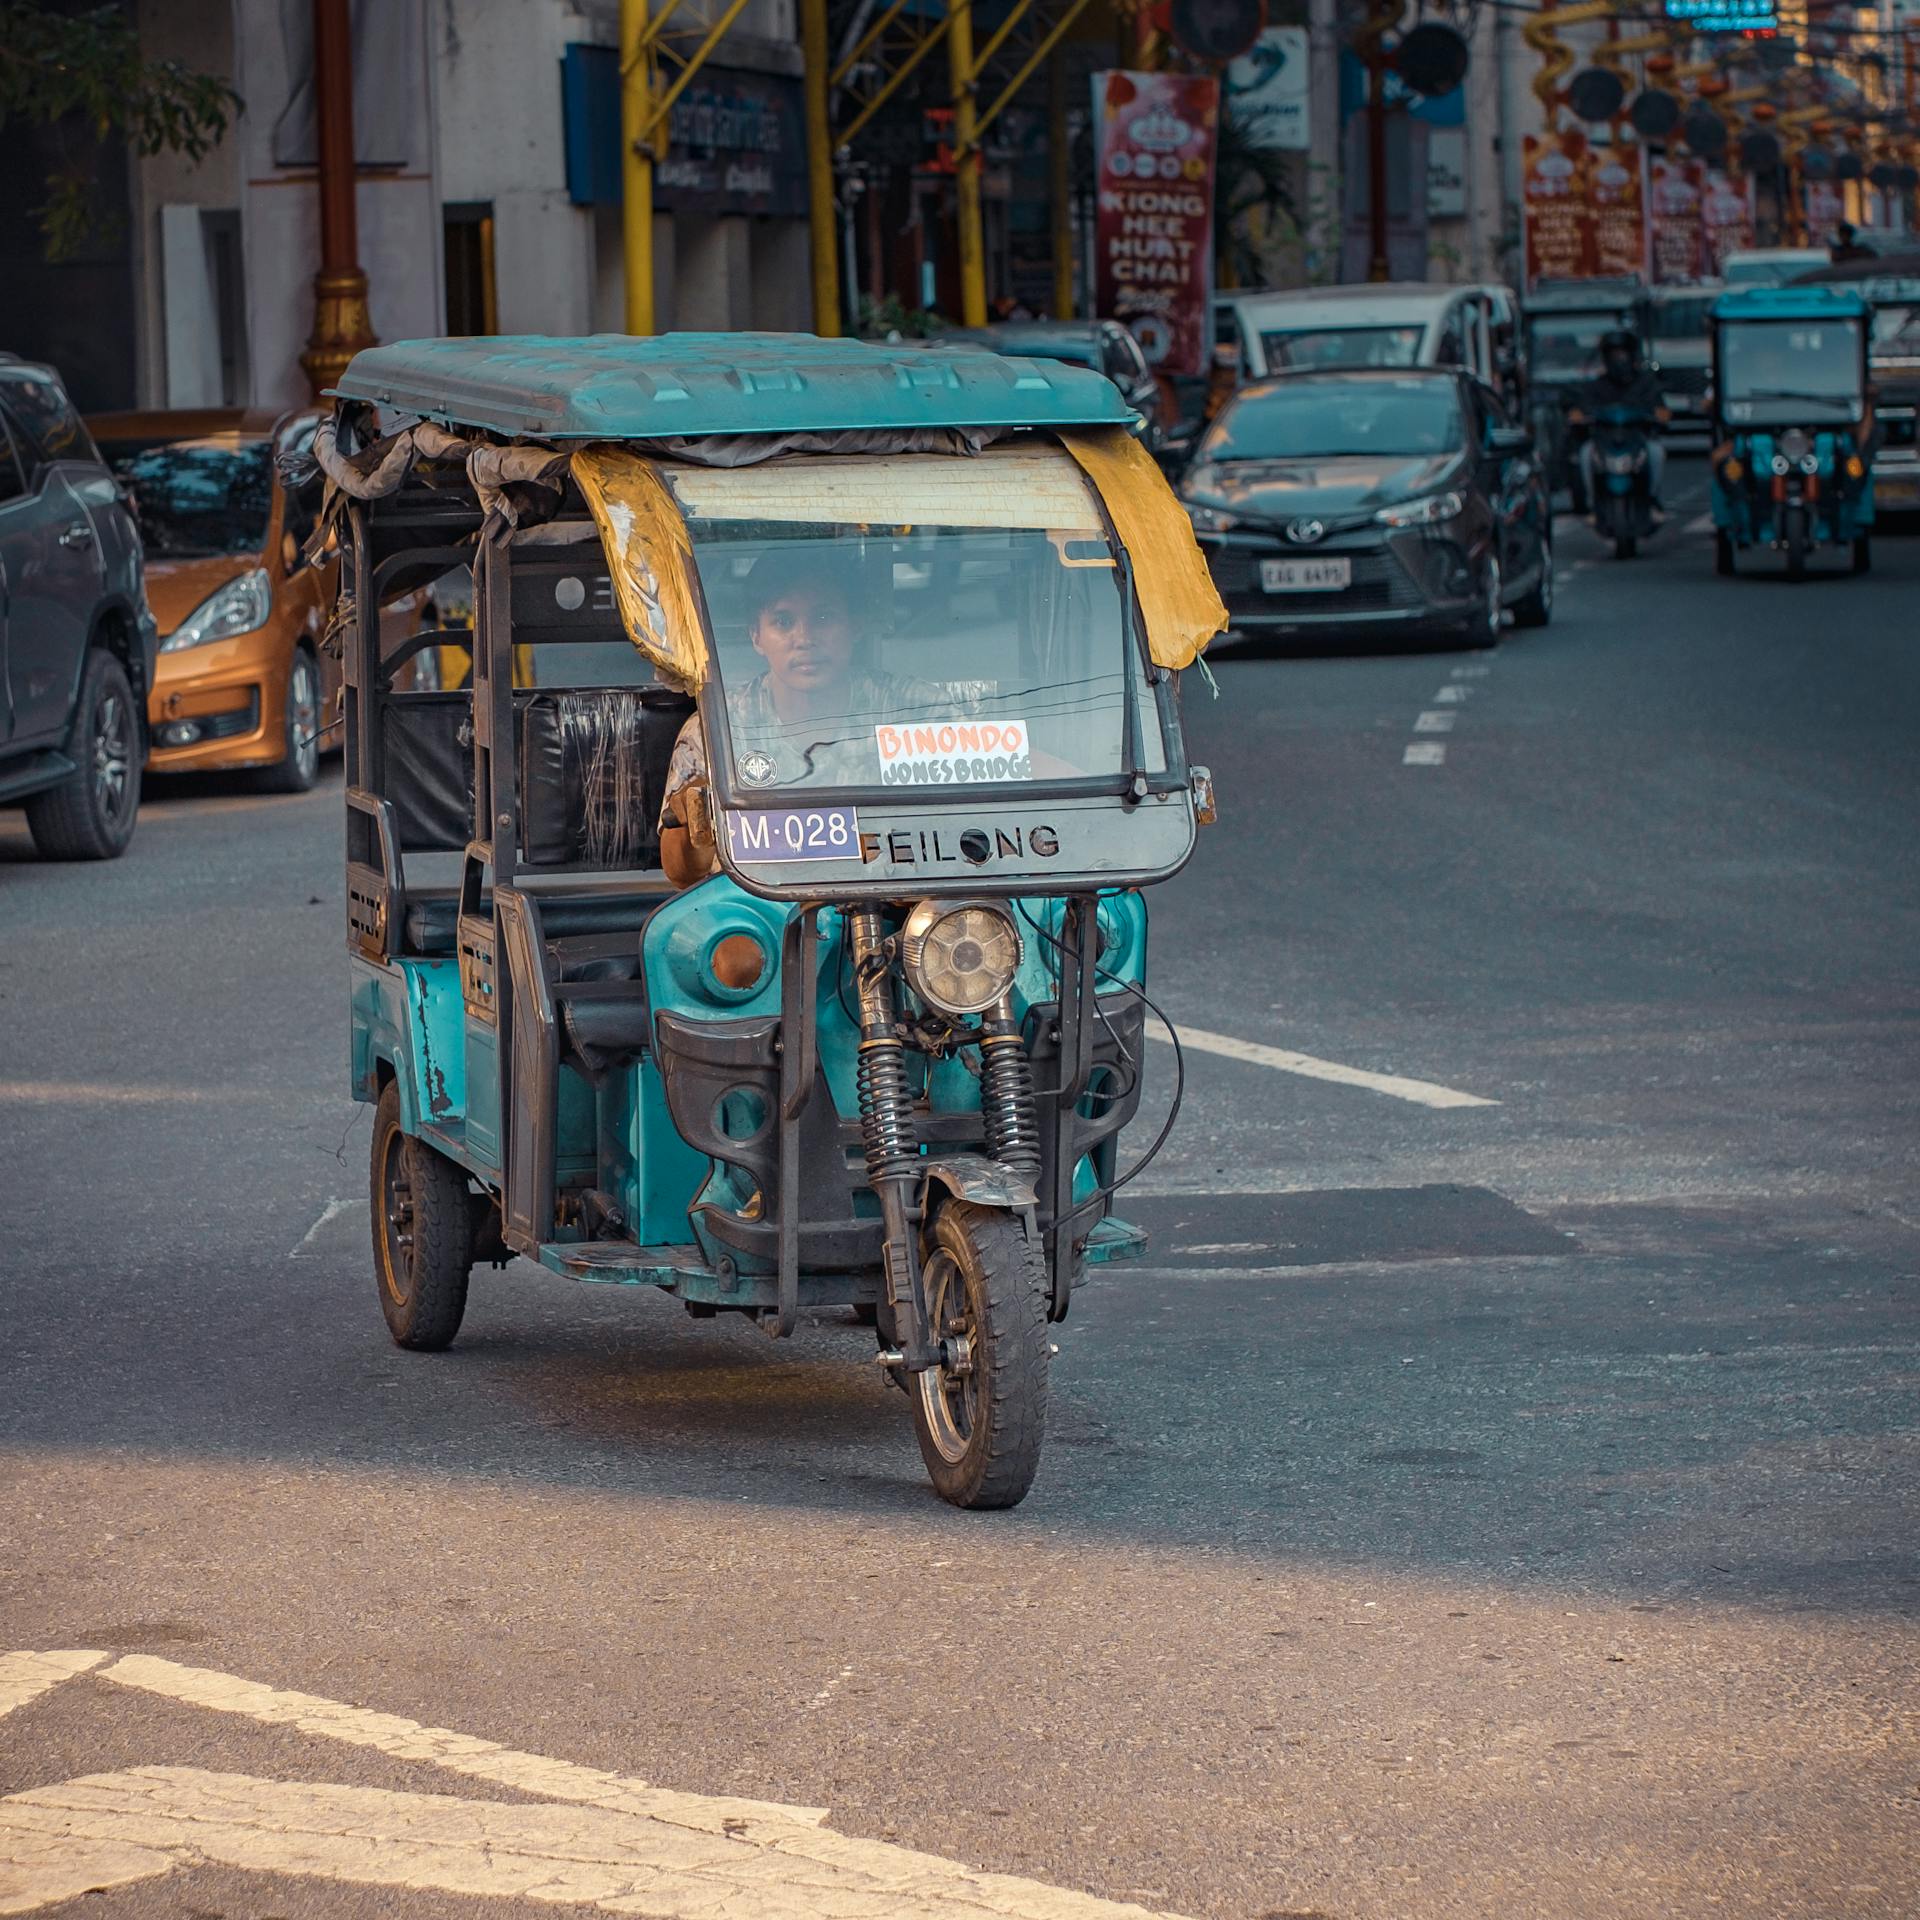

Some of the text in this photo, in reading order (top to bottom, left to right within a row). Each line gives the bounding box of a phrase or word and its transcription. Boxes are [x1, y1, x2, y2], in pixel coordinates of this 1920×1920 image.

[1100, 192, 1205, 217] KIONG
[1122, 215, 1186, 238] HEE
[1108, 237, 1196, 259] HUAT
[1111, 259, 1190, 283] CHAI
[879, 725, 1022, 760] BINONDO
[861, 825, 1060, 866] FEILONG
